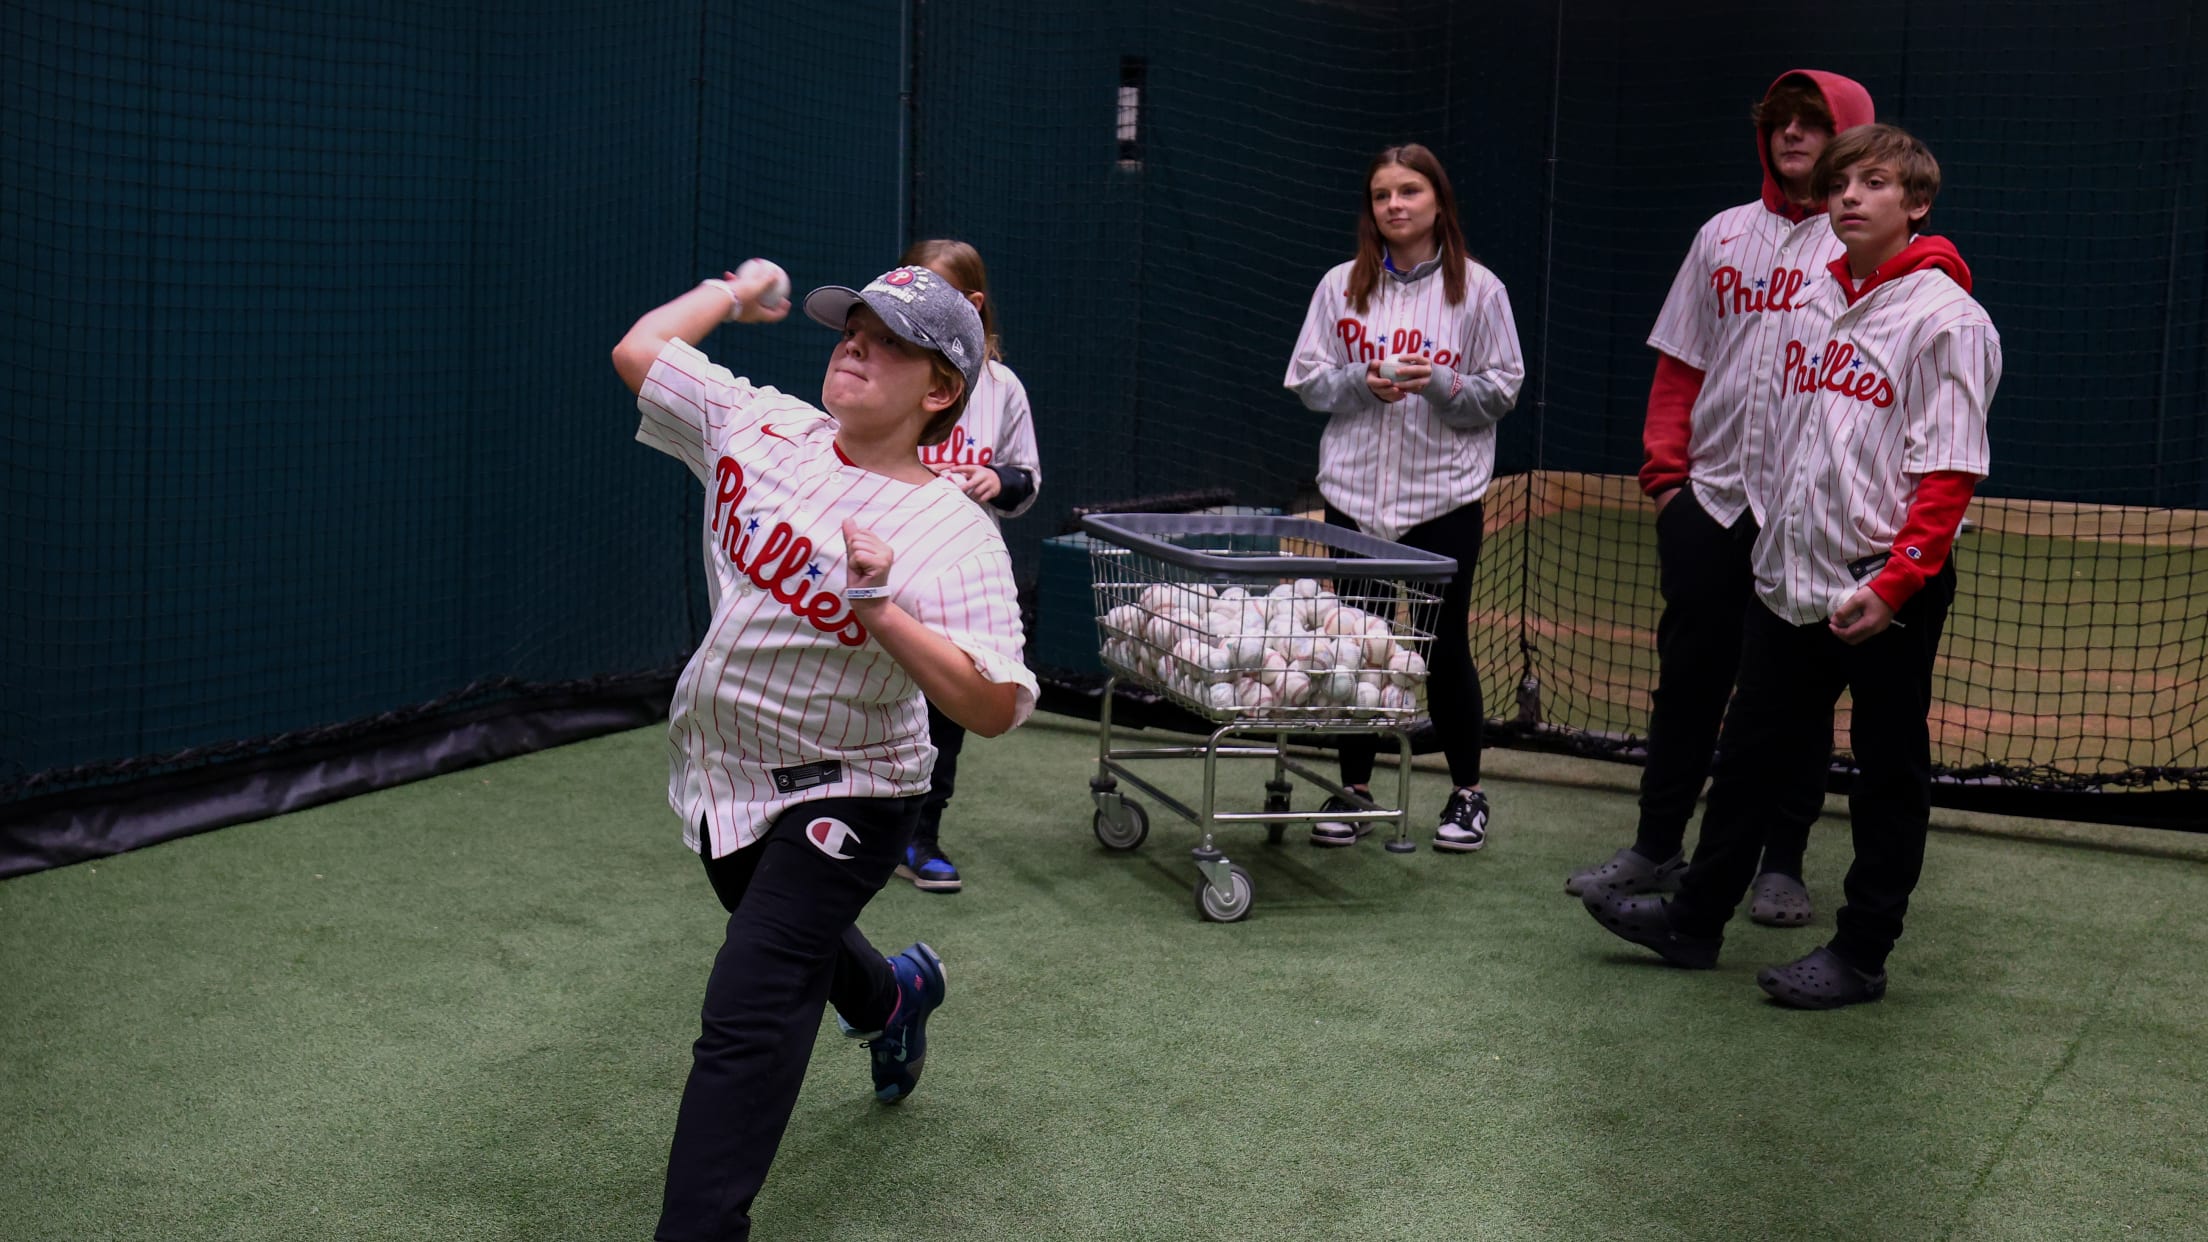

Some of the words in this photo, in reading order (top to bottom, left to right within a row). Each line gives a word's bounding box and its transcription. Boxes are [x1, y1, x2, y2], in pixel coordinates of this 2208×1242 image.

[1711, 266, 1811, 318] Phill
[1782, 340, 1894, 407] Phillies
[712, 455, 867, 646] Phillies
